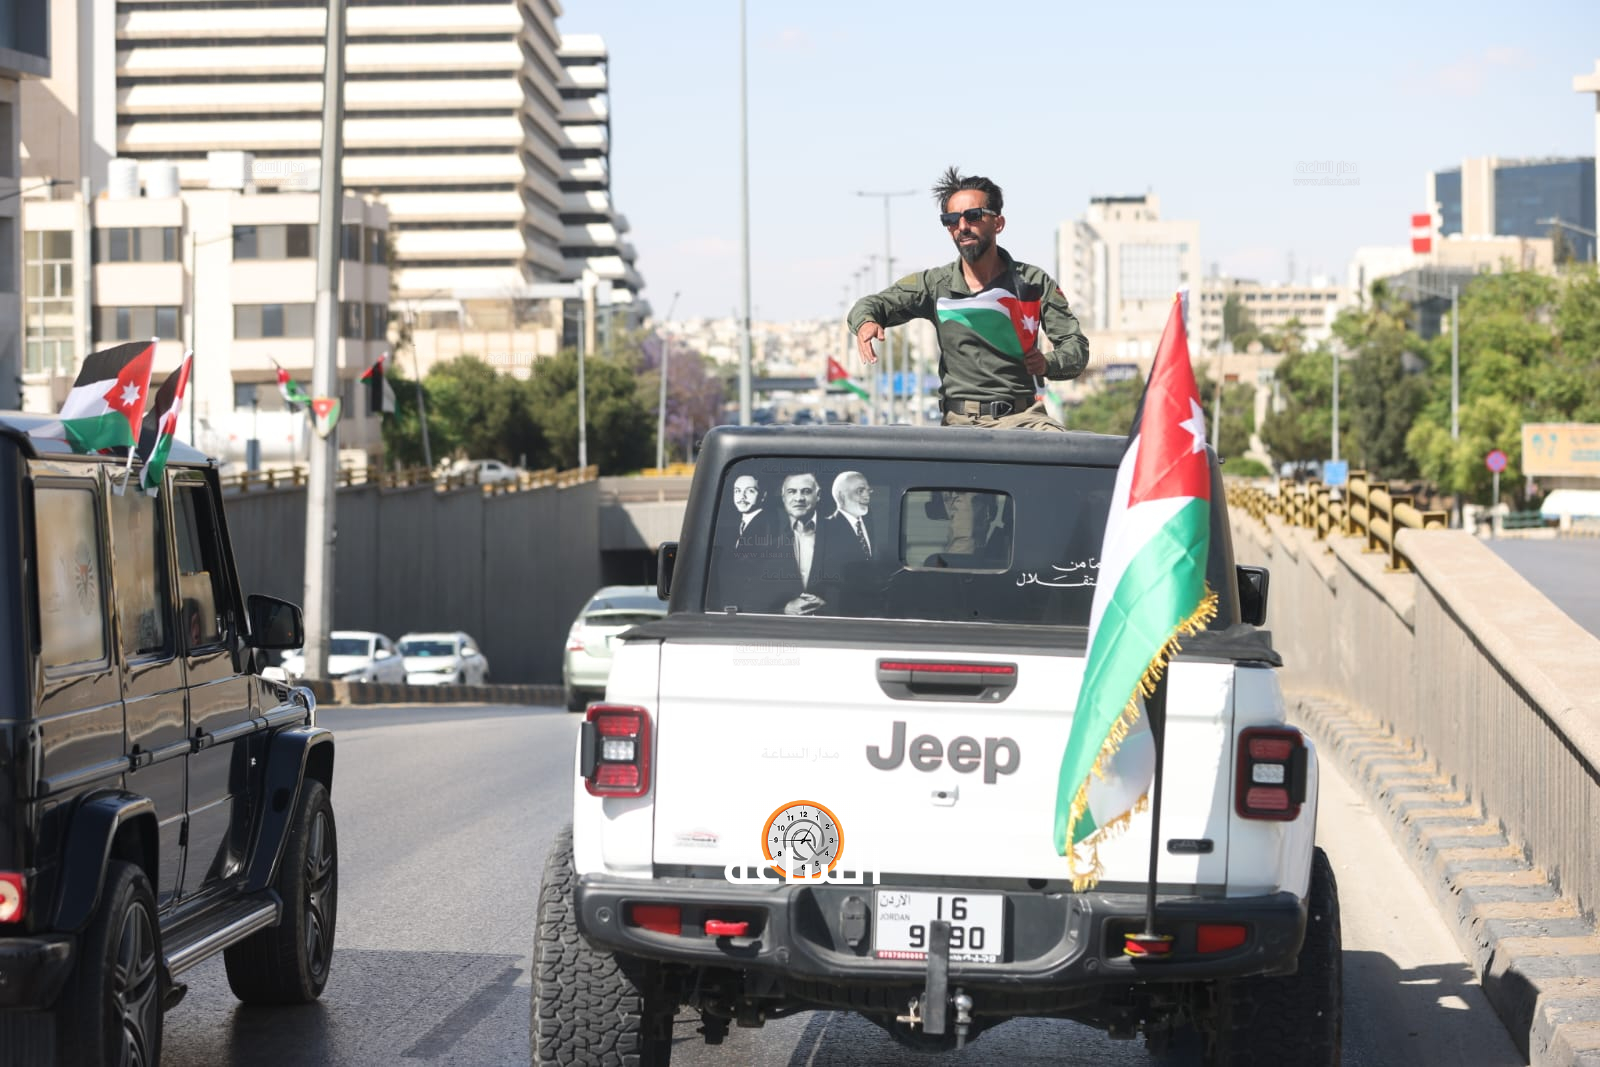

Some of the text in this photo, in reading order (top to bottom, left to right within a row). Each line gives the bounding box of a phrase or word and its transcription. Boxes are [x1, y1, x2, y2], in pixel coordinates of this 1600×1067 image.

[866, 721, 1021, 785] Jeep
[879, 913, 911, 921] JORDAN
[937, 896, 968, 921] 16
[908, 924, 985, 950] 990
